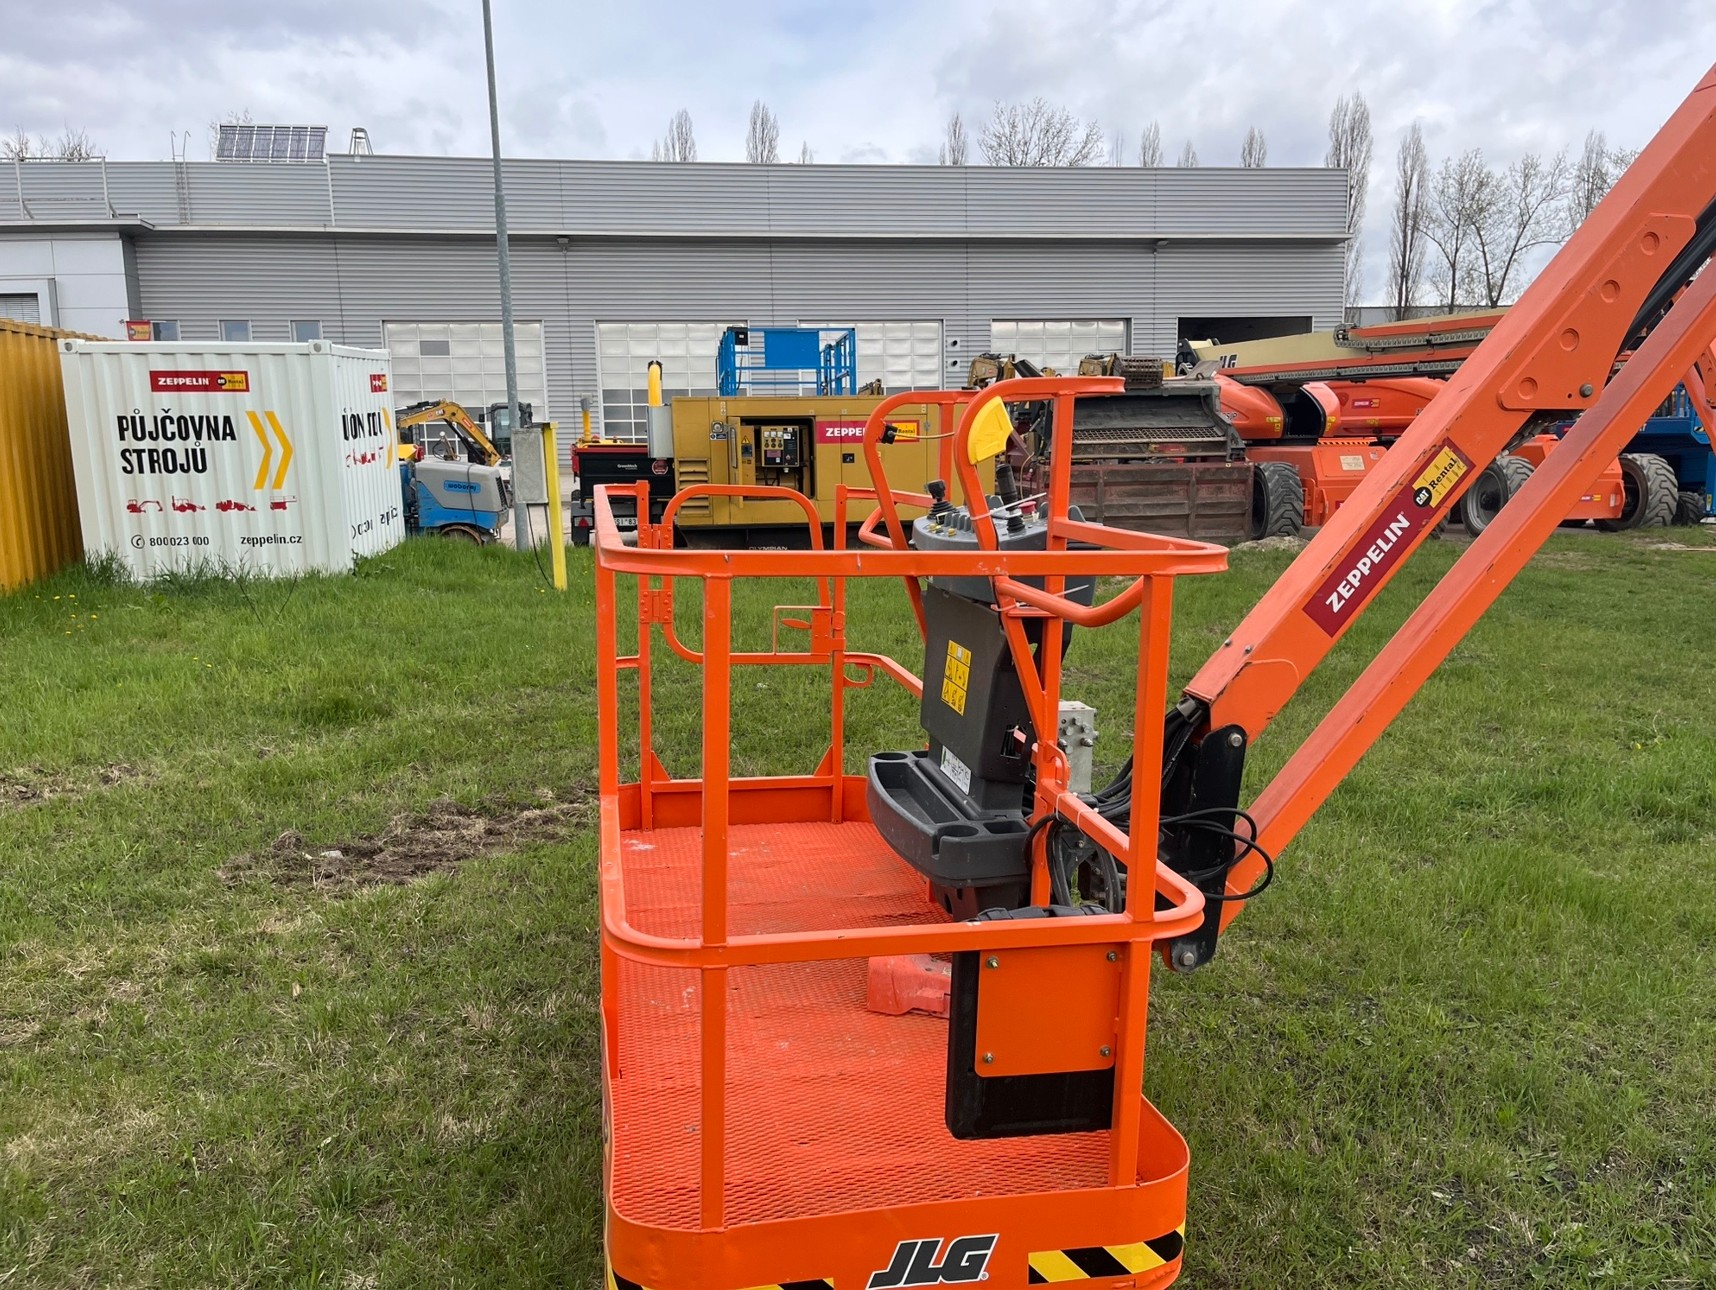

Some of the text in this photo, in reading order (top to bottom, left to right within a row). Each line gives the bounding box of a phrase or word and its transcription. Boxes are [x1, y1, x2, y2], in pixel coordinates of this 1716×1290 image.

[158, 377, 209, 386] ZEPPELIN
[117, 408, 237, 442] PŮJČOVNA
[120, 441, 208, 475] STROJŮ
[1415, 457, 1458, 505] CAT Rental
[240, 533, 303, 548] zeppelin.cz
[1325, 513, 1411, 613] ZEPPELIN
[865, 1233, 1000, 1290] JLG
